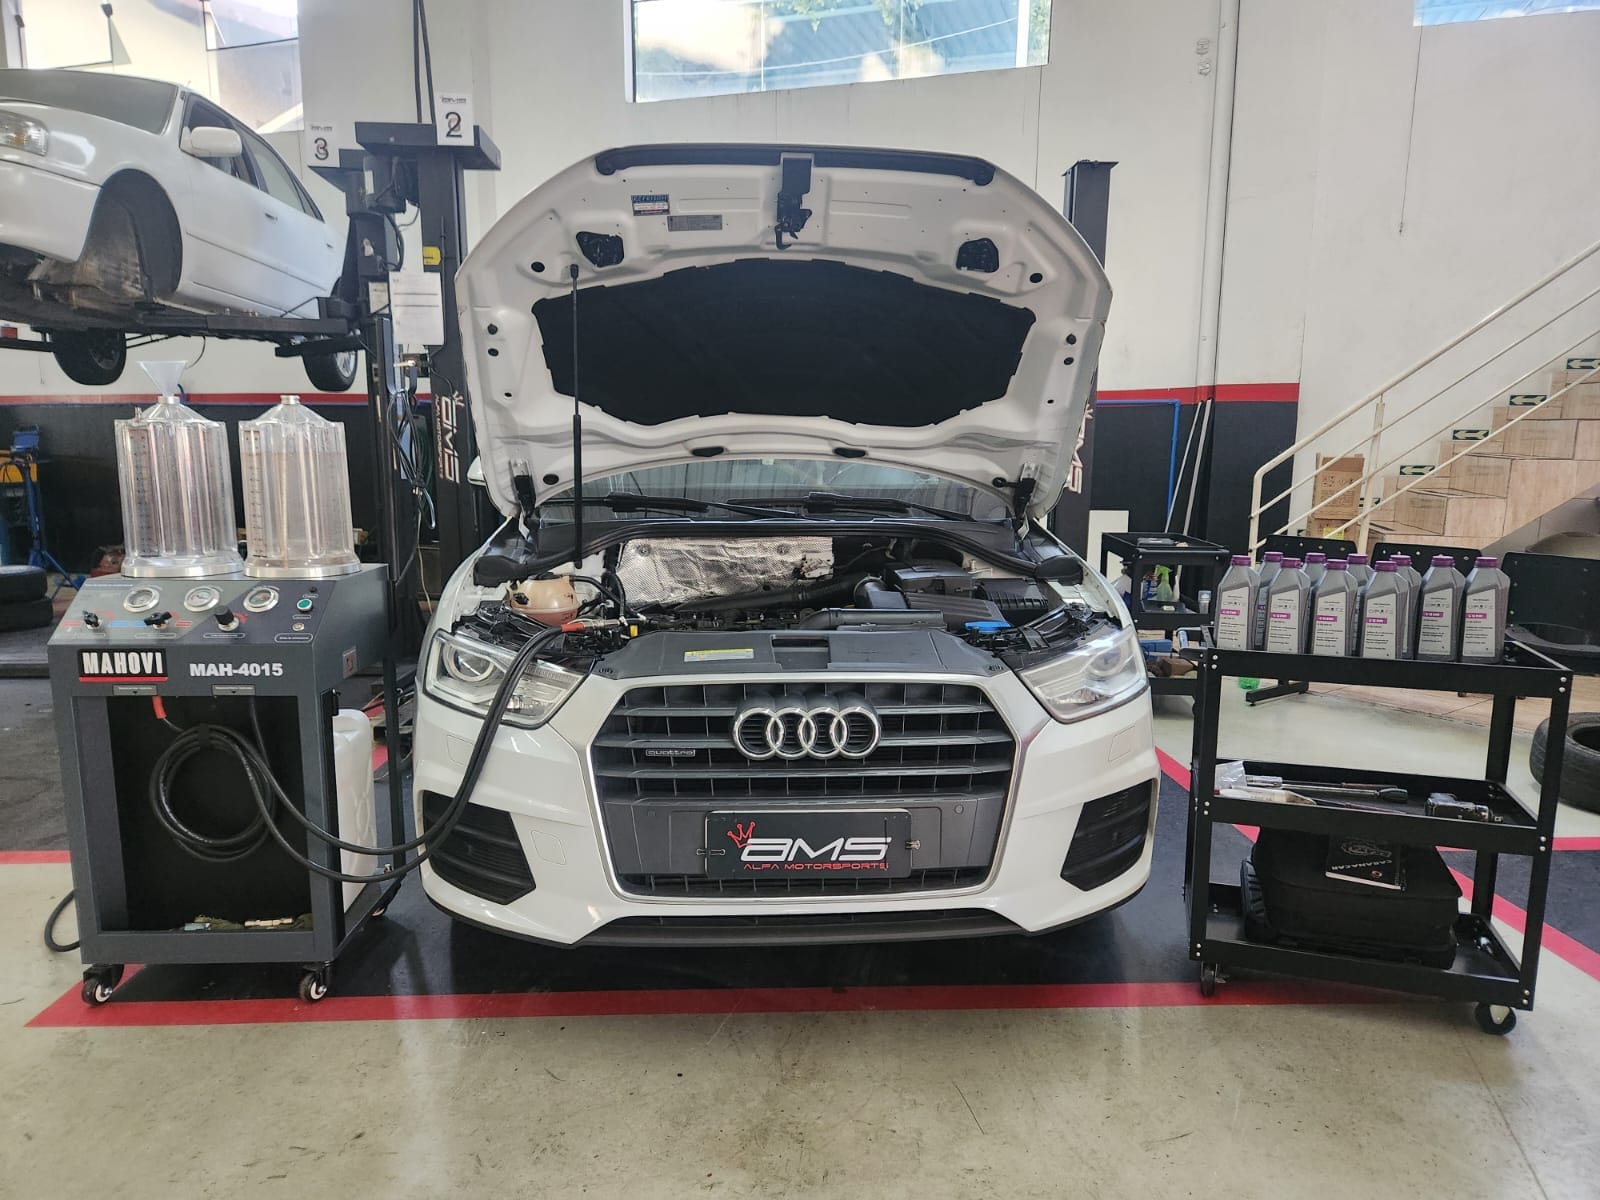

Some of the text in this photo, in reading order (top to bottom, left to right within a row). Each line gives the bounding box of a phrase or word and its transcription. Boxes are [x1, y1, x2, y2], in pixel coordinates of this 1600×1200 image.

[445, 111, 463, 138] 2
[314, 137, 329, 160] 3
[82, 652, 163, 674] MAHOVI
[189, 662, 284, 677] MAH-4015
[784, 863, 889, 871] MOTORSPORTS
